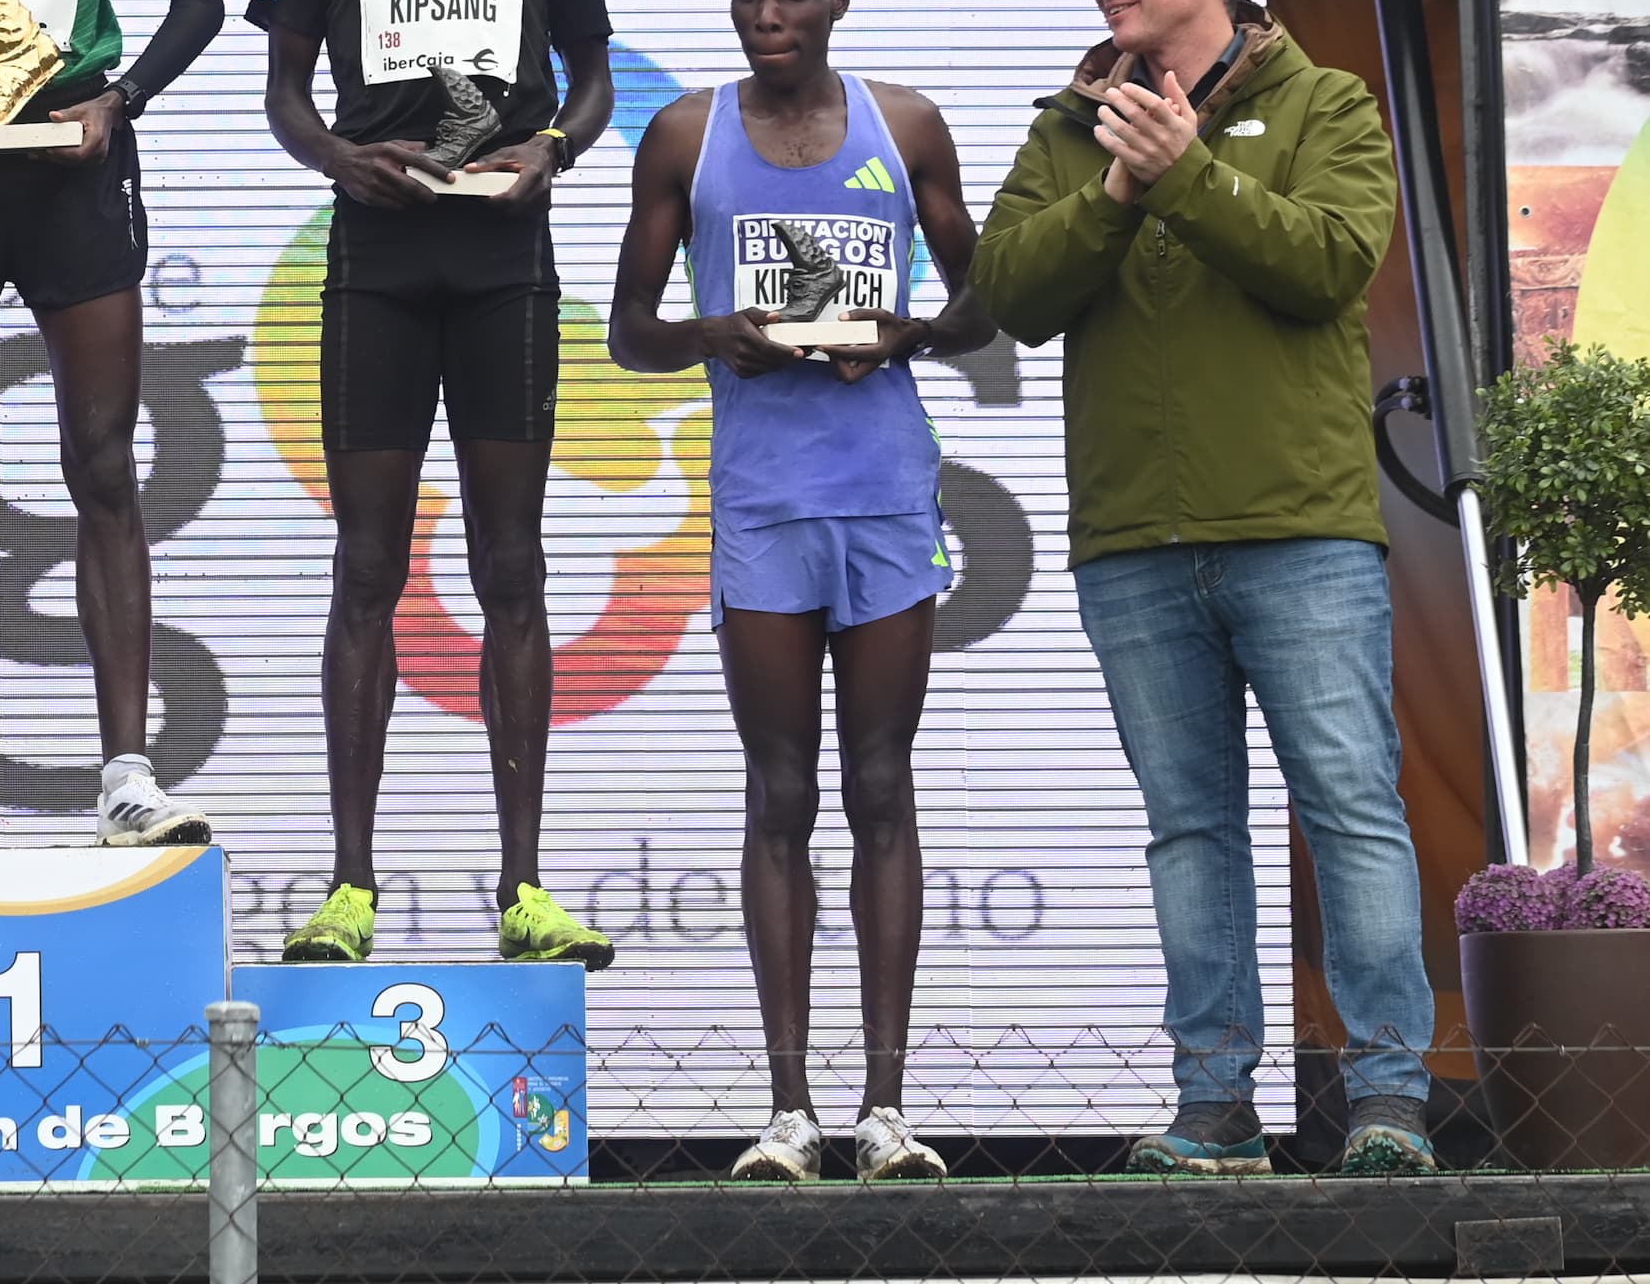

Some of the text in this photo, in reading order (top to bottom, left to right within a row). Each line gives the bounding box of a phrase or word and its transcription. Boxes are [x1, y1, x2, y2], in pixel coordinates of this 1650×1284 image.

[378, 31, 401, 50] 138
[383, 52, 455, 72] iberCaja
[745, 237, 886, 267] BUGOS
[368, 982, 450, 1083] 3
[37, 1105, 131, 1150] de
[155, 1105, 433, 1157] Brgos
